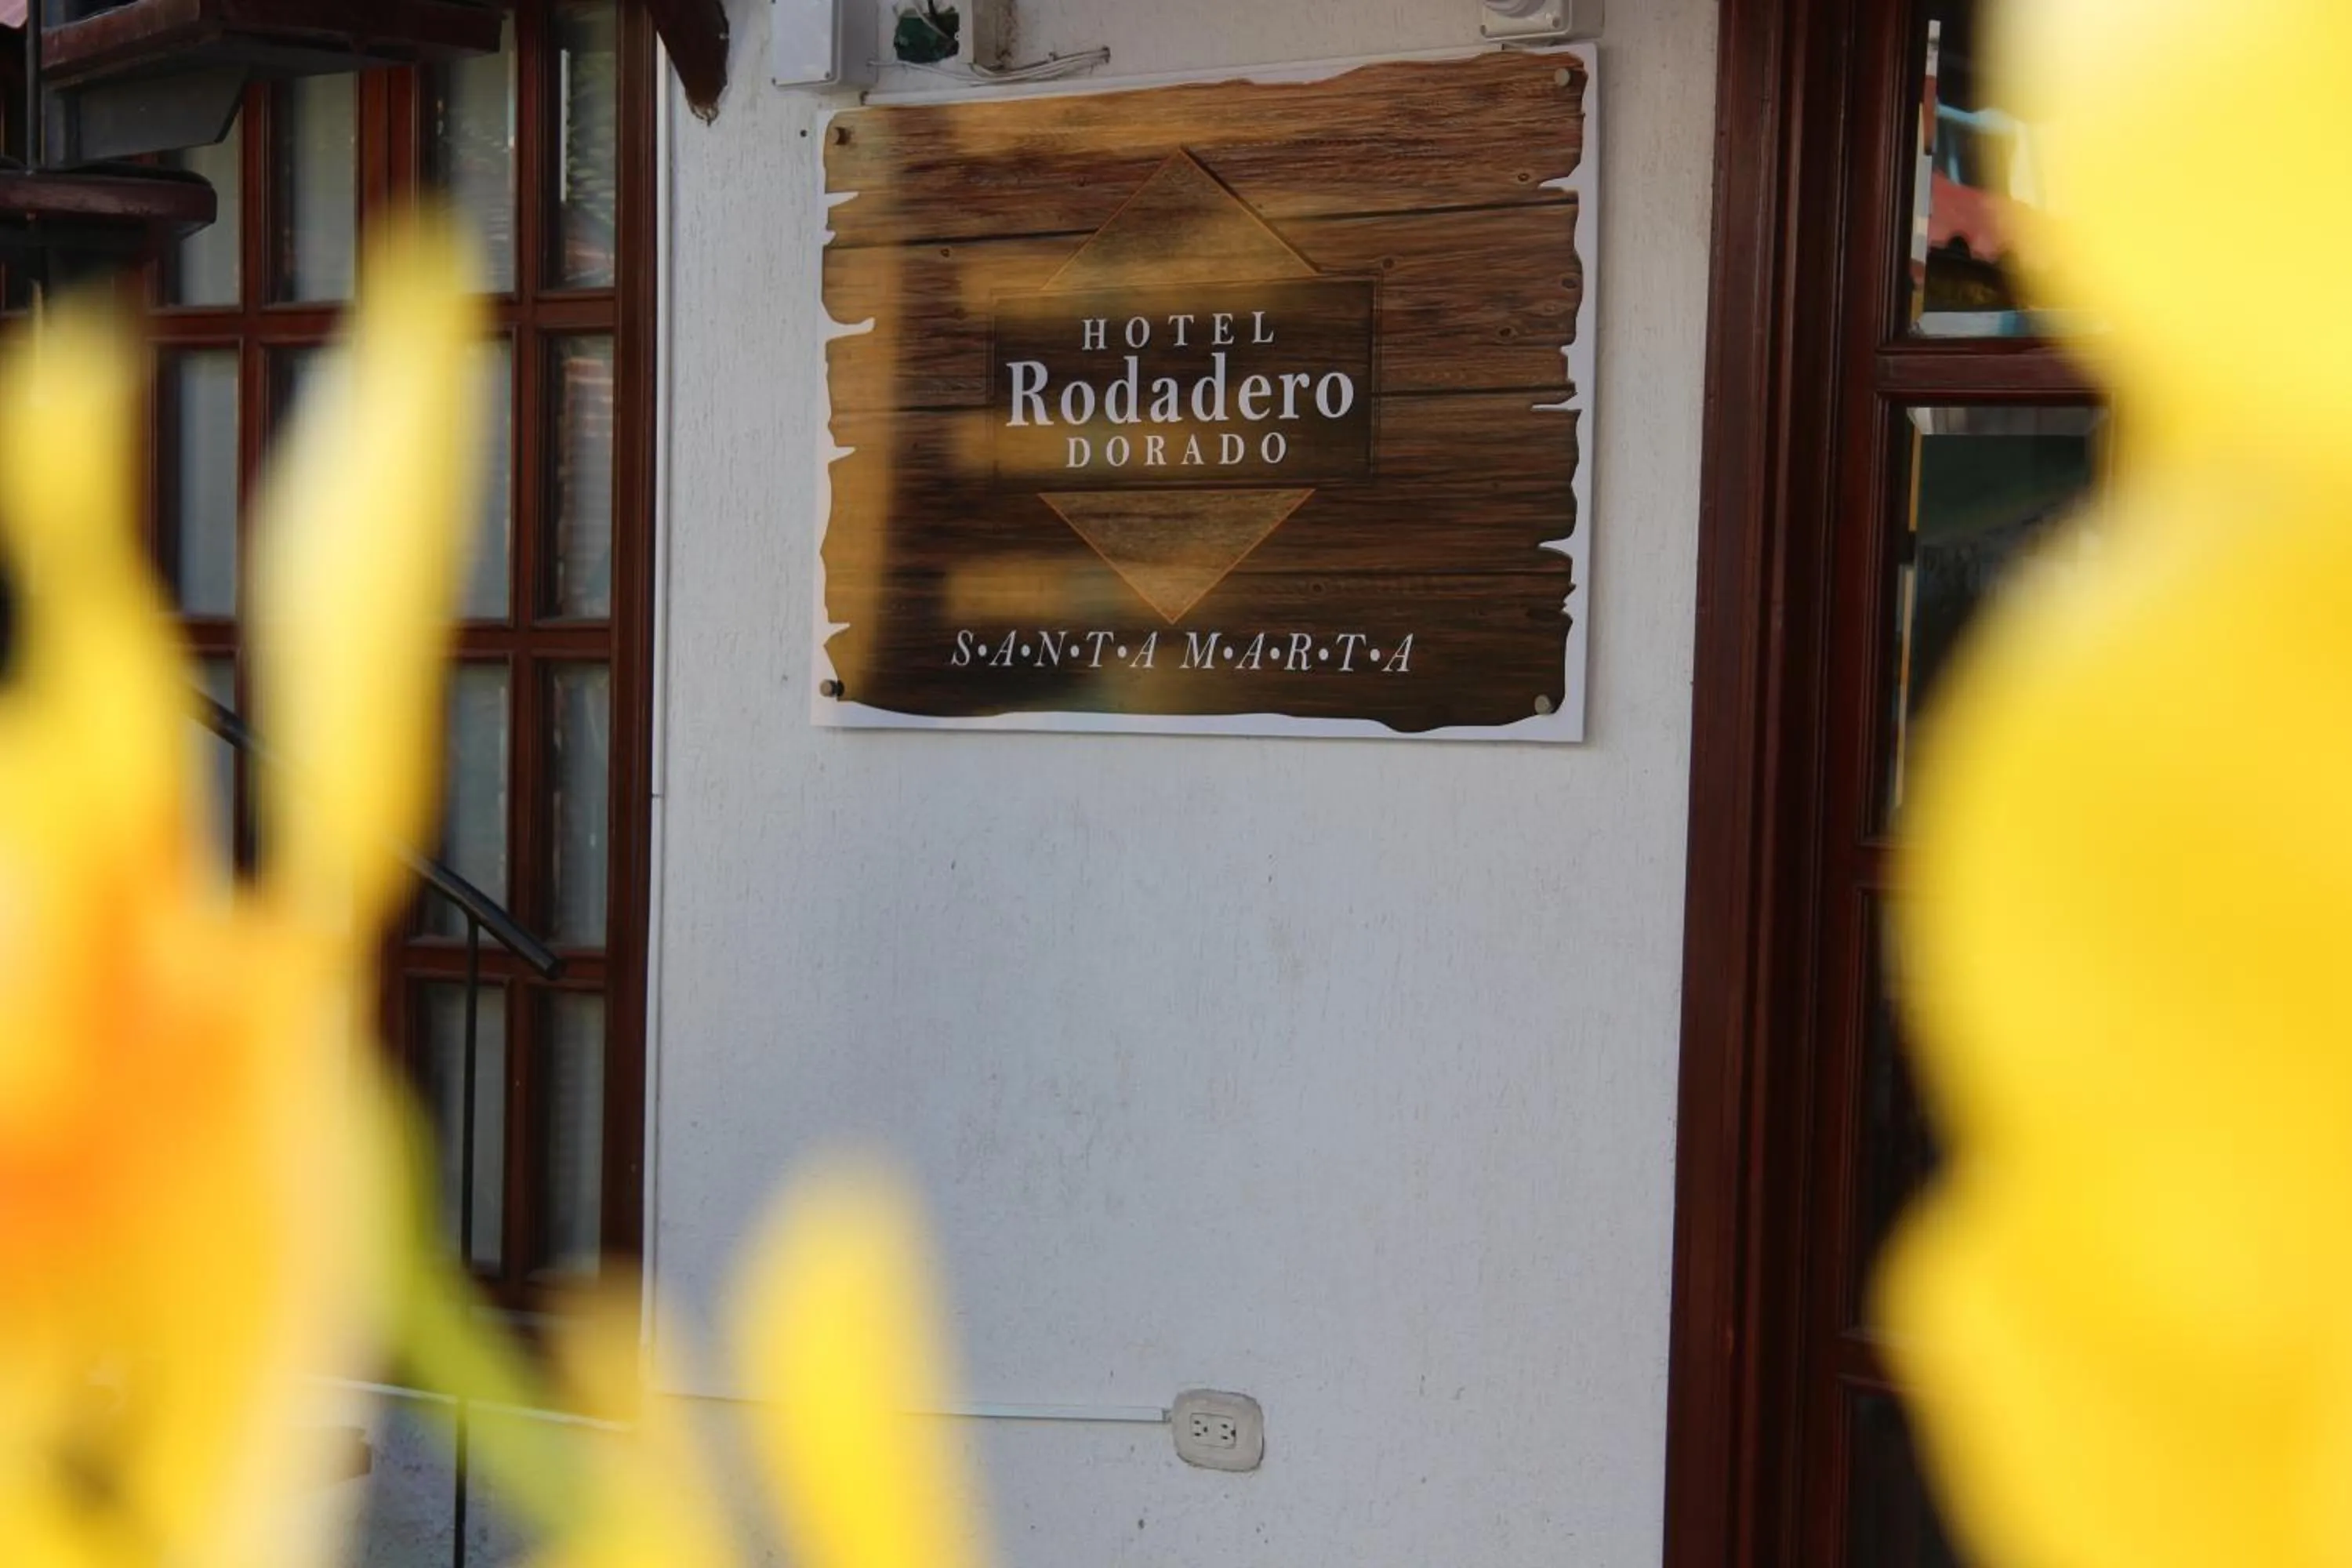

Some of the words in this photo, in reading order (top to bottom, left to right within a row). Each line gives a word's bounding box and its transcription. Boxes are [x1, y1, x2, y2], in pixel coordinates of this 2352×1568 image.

[1081, 311, 1275, 350] HOTEL
[1006, 352, 1355, 426] Rodadero
[1065, 431, 1287, 468] DORADO
